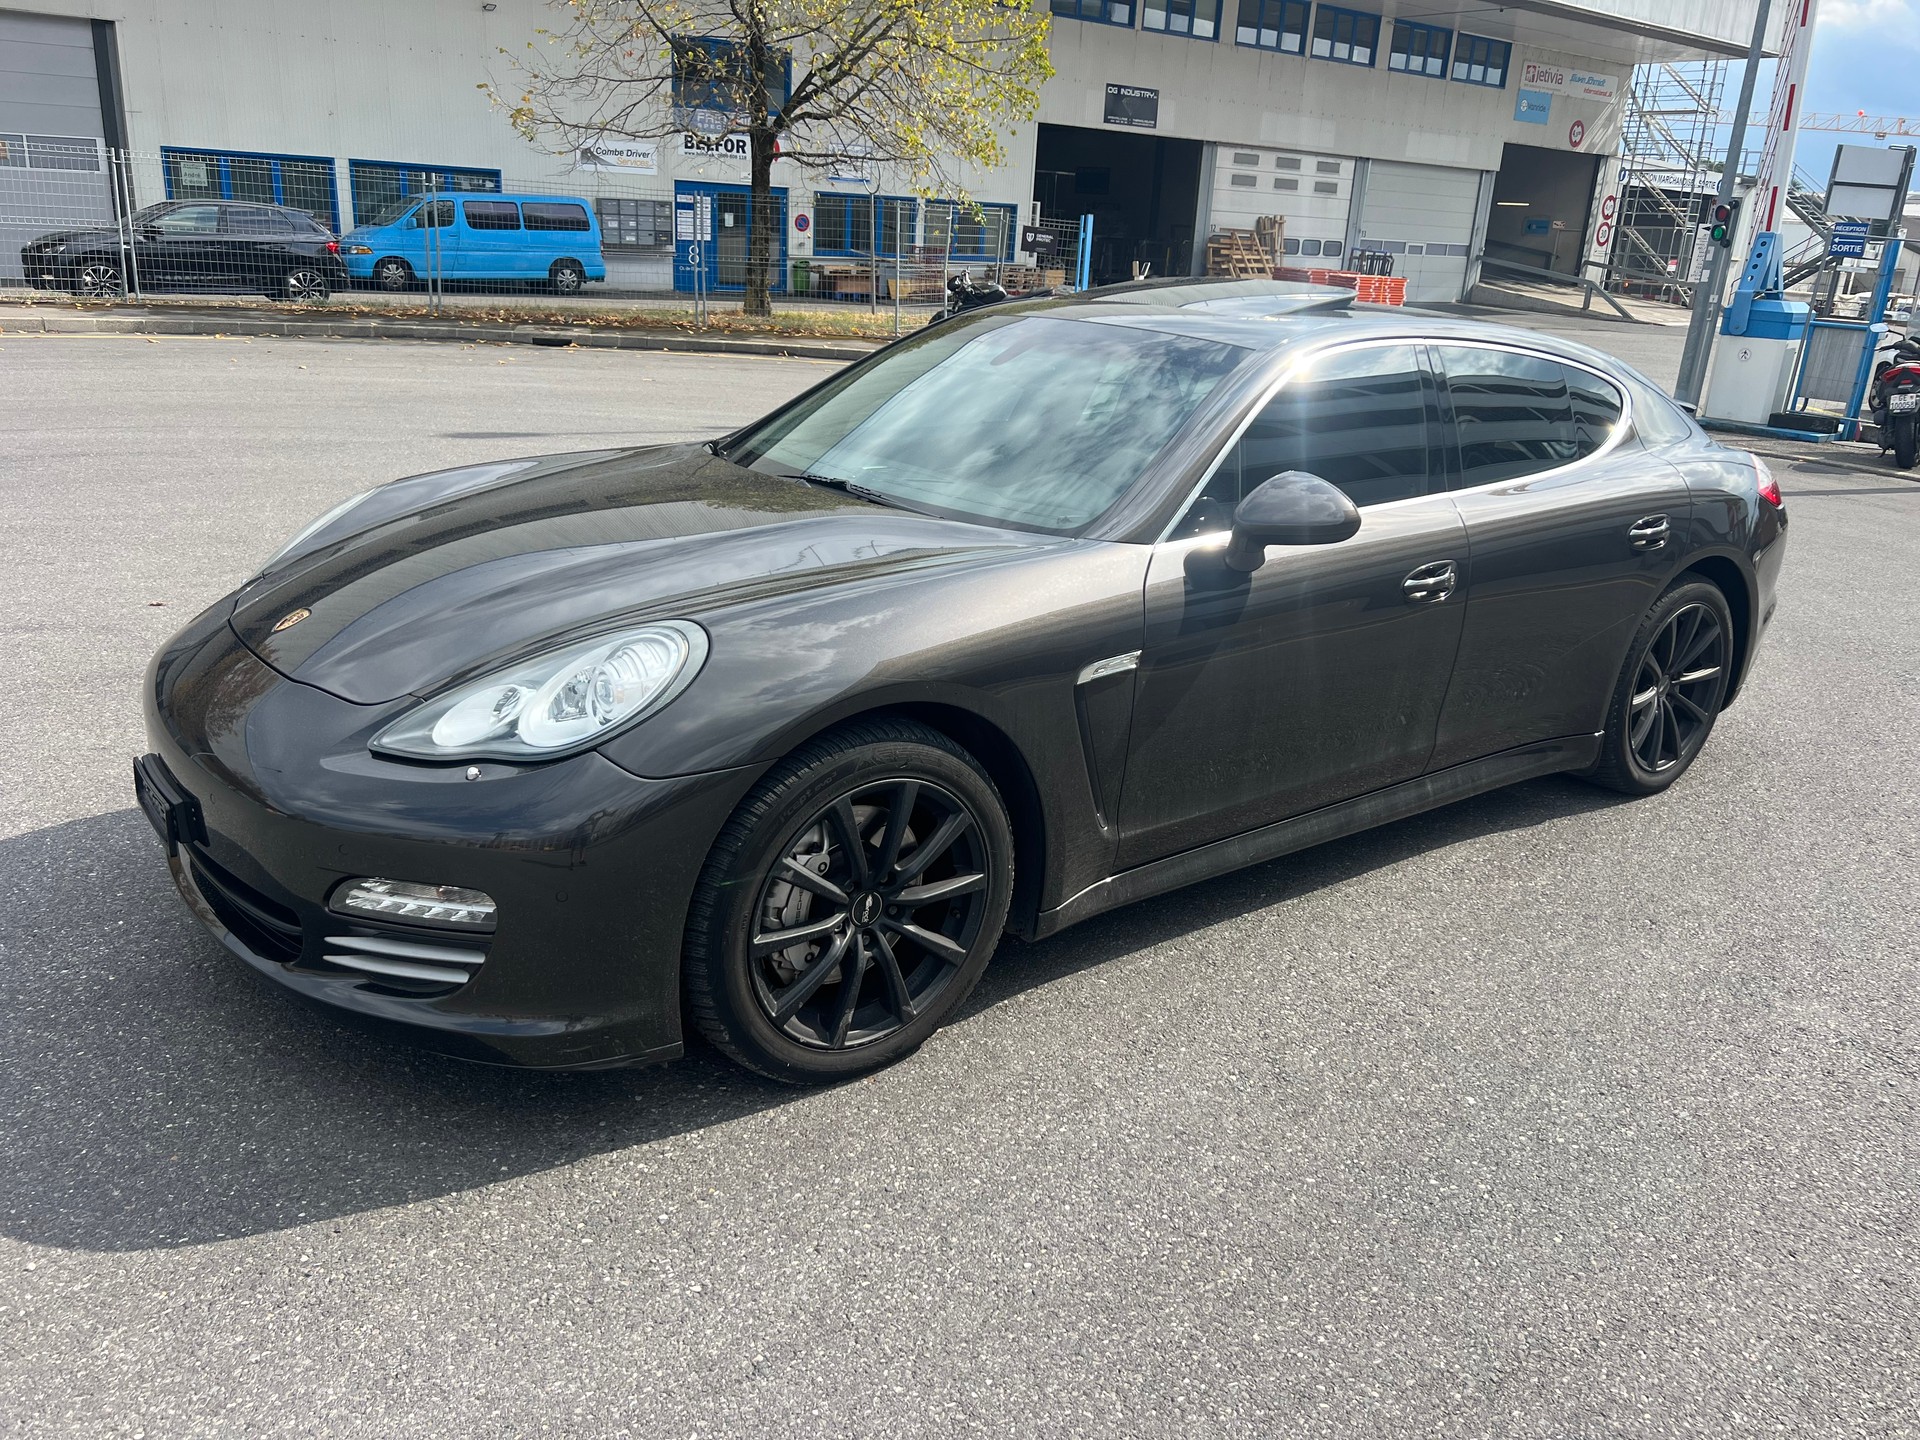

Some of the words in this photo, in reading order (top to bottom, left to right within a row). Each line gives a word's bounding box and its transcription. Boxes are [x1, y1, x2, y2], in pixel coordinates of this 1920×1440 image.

[596, 146, 624, 157] Combe
[626, 149, 651, 158] Driver
[617, 156, 650, 167] Services
[1698, 179, 1717, 190] SRTIE
[1831, 244, 1863, 253] SORTIE
